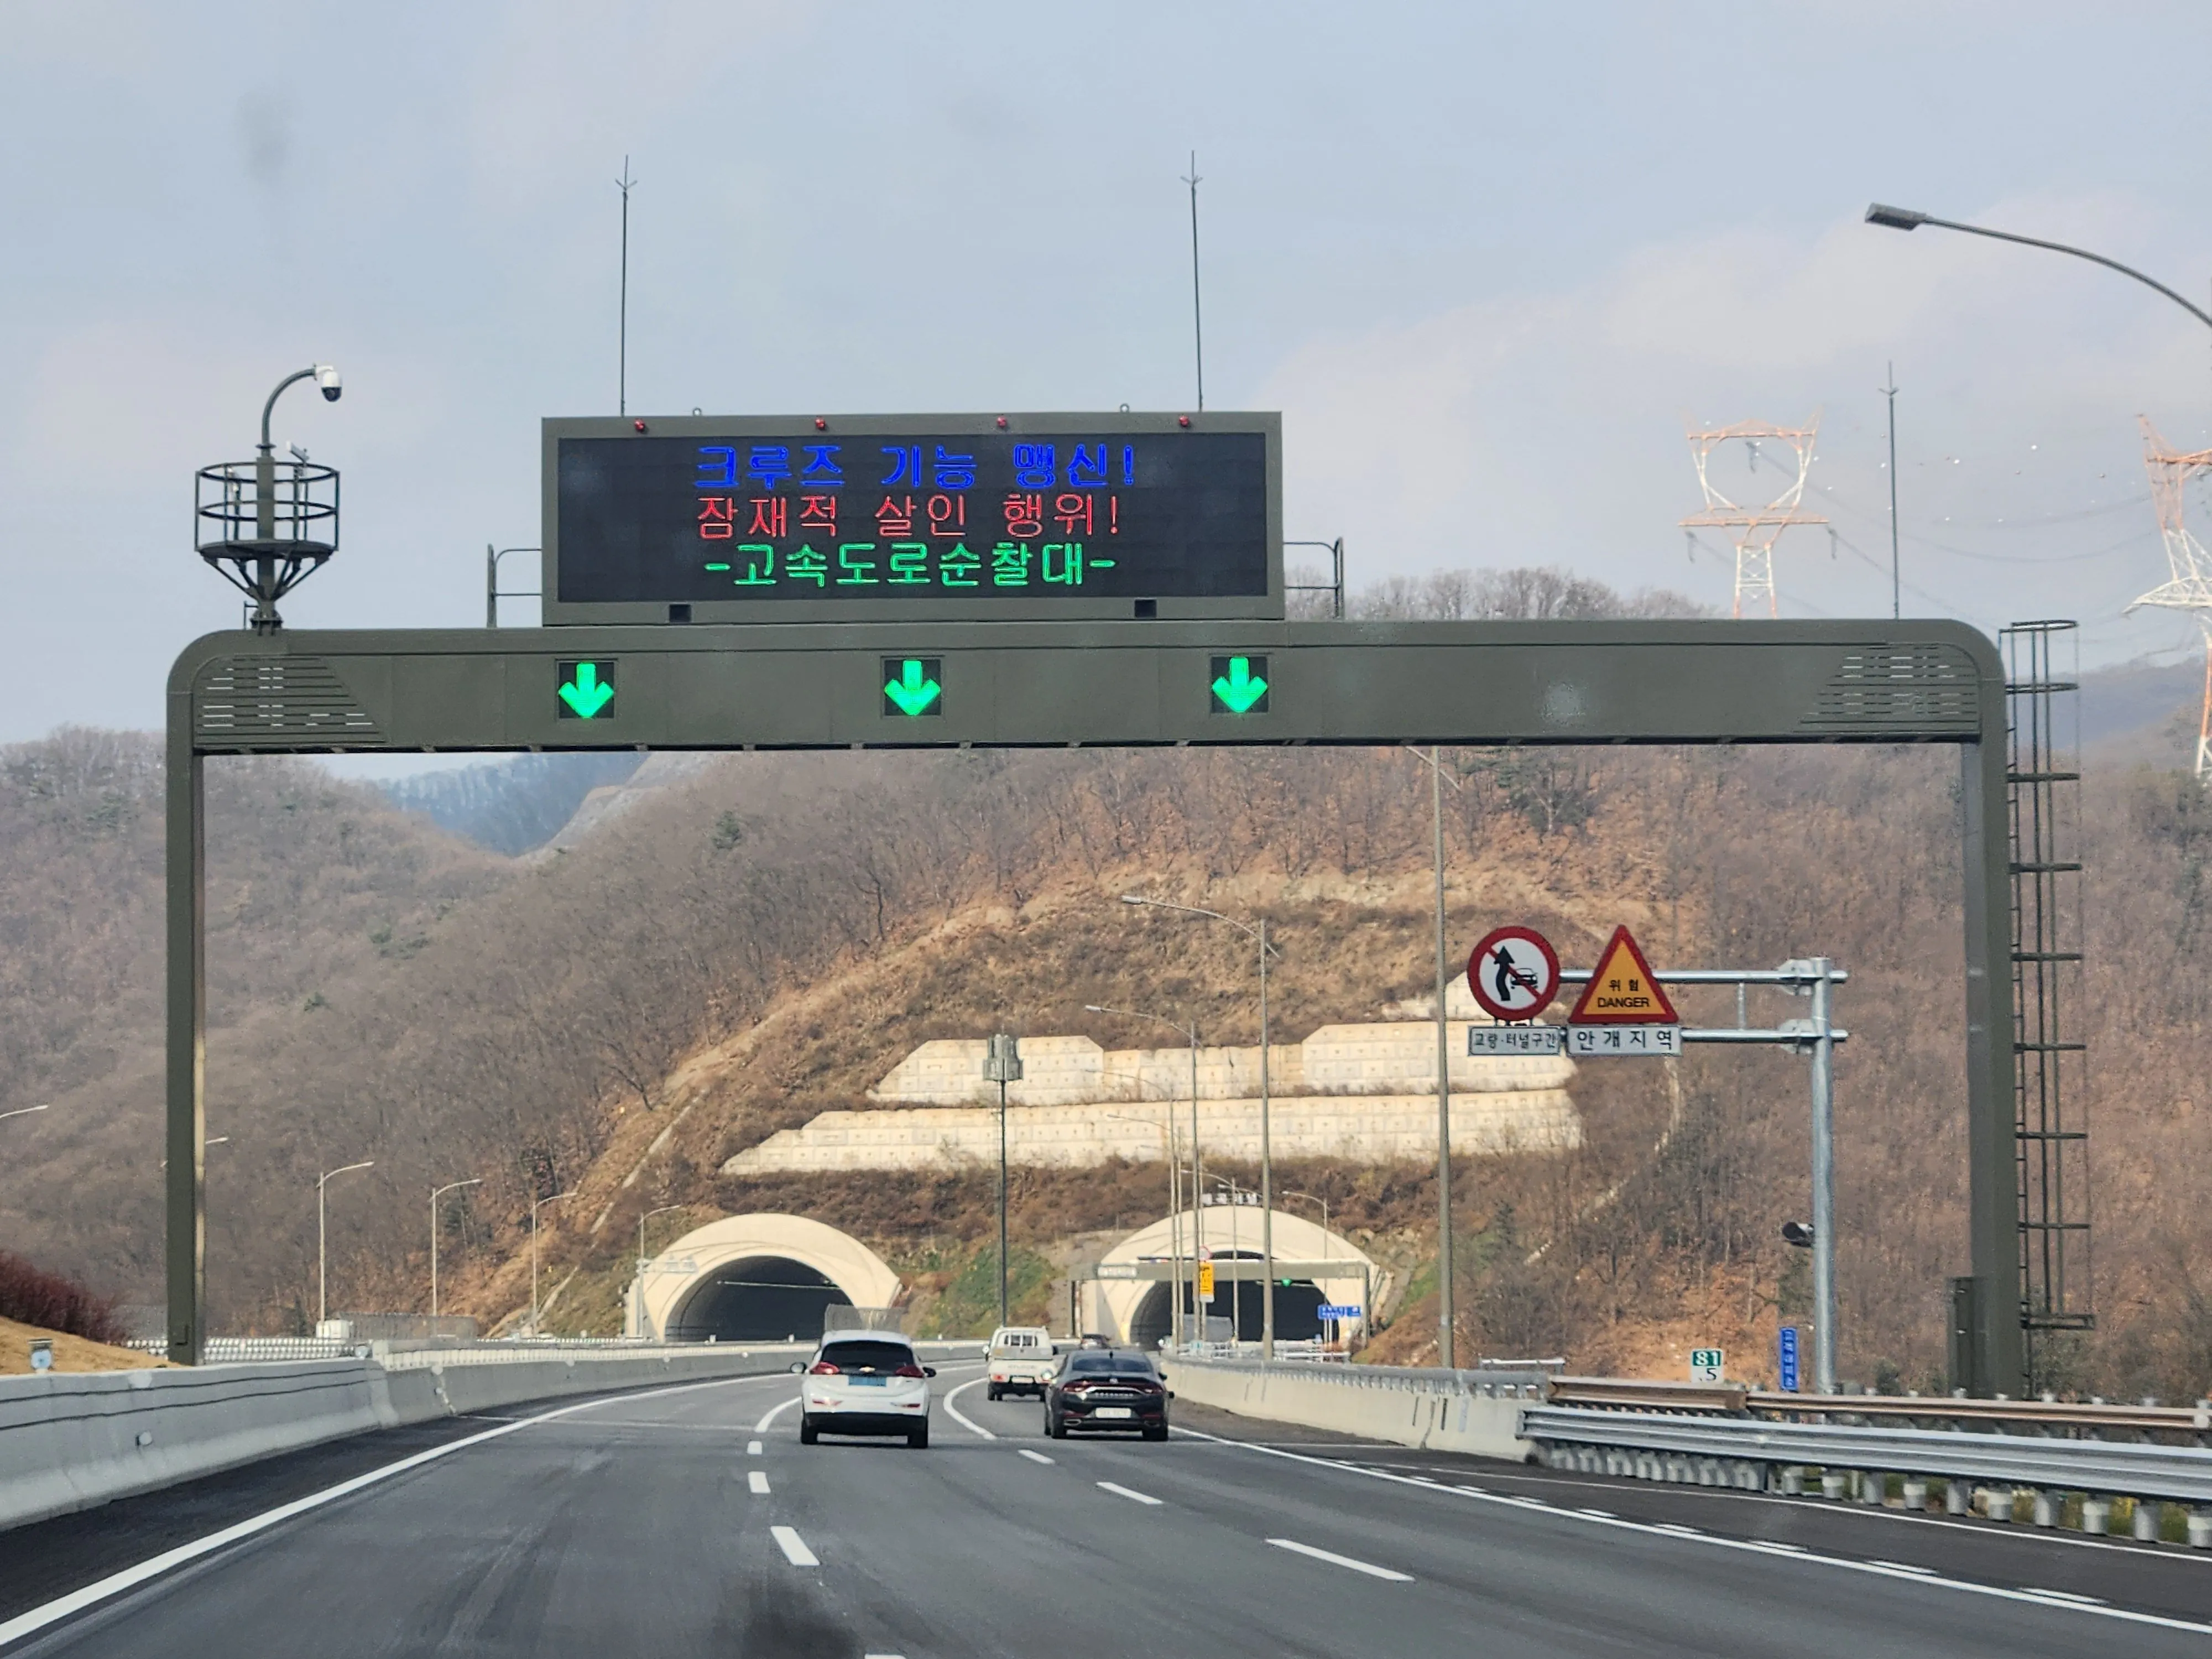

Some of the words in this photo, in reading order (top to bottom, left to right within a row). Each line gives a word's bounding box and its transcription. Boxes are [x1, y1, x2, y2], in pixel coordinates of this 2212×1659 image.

[694, 445, 846, 488] 크루즈
[880, 444, 978, 489] 기능
[1013, 443, 1136, 489] 맹신!
[697, 495, 838, 540] 잠재적
[875, 494, 968, 538] 살인
[1004, 493, 1119, 536] 행위!
[704, 542, 1117, 588] -고속도로순찰대-
[1609, 979, 1639, 992] 위험
[1597, 997, 1650, 1008] DANGER
[1577, 1030, 1672, 1050] 안개지역
[1695, 1351, 1718, 1366] 81
